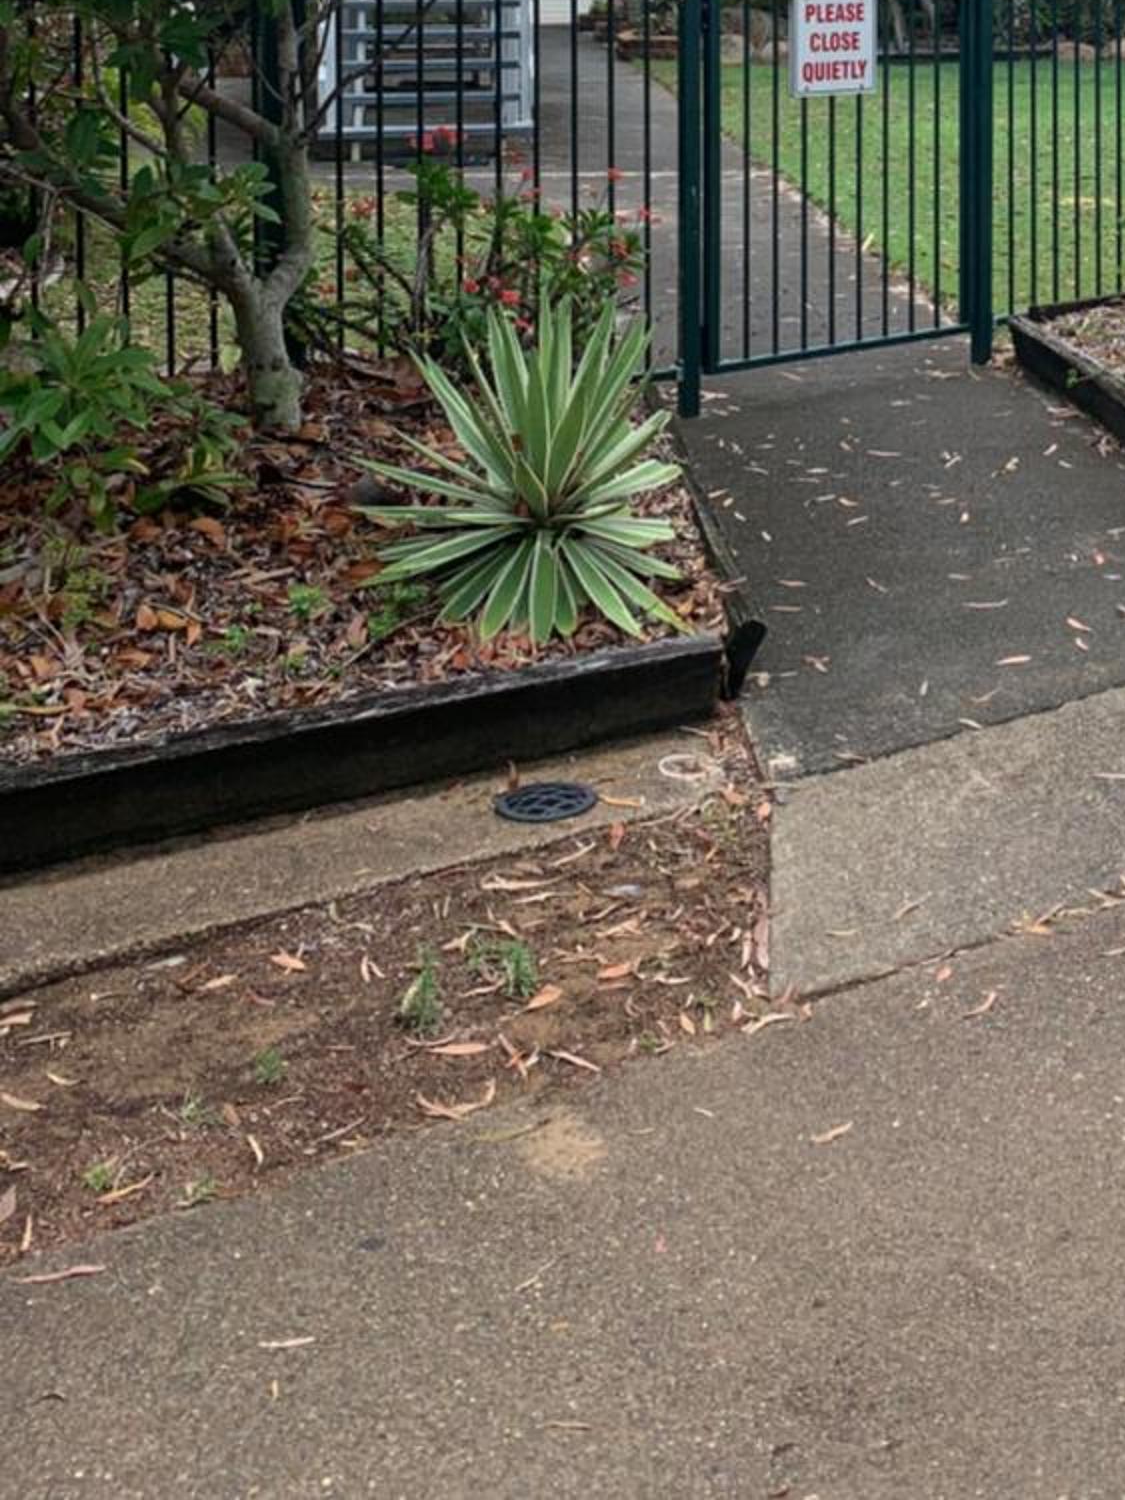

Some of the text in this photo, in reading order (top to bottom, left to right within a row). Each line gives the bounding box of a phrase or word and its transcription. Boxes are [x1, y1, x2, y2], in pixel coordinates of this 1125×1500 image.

[805, 3, 864, 22] PLEASE
[809, 32, 860, 52] CLOSE
[802, 60, 867, 83] QUIETLY
